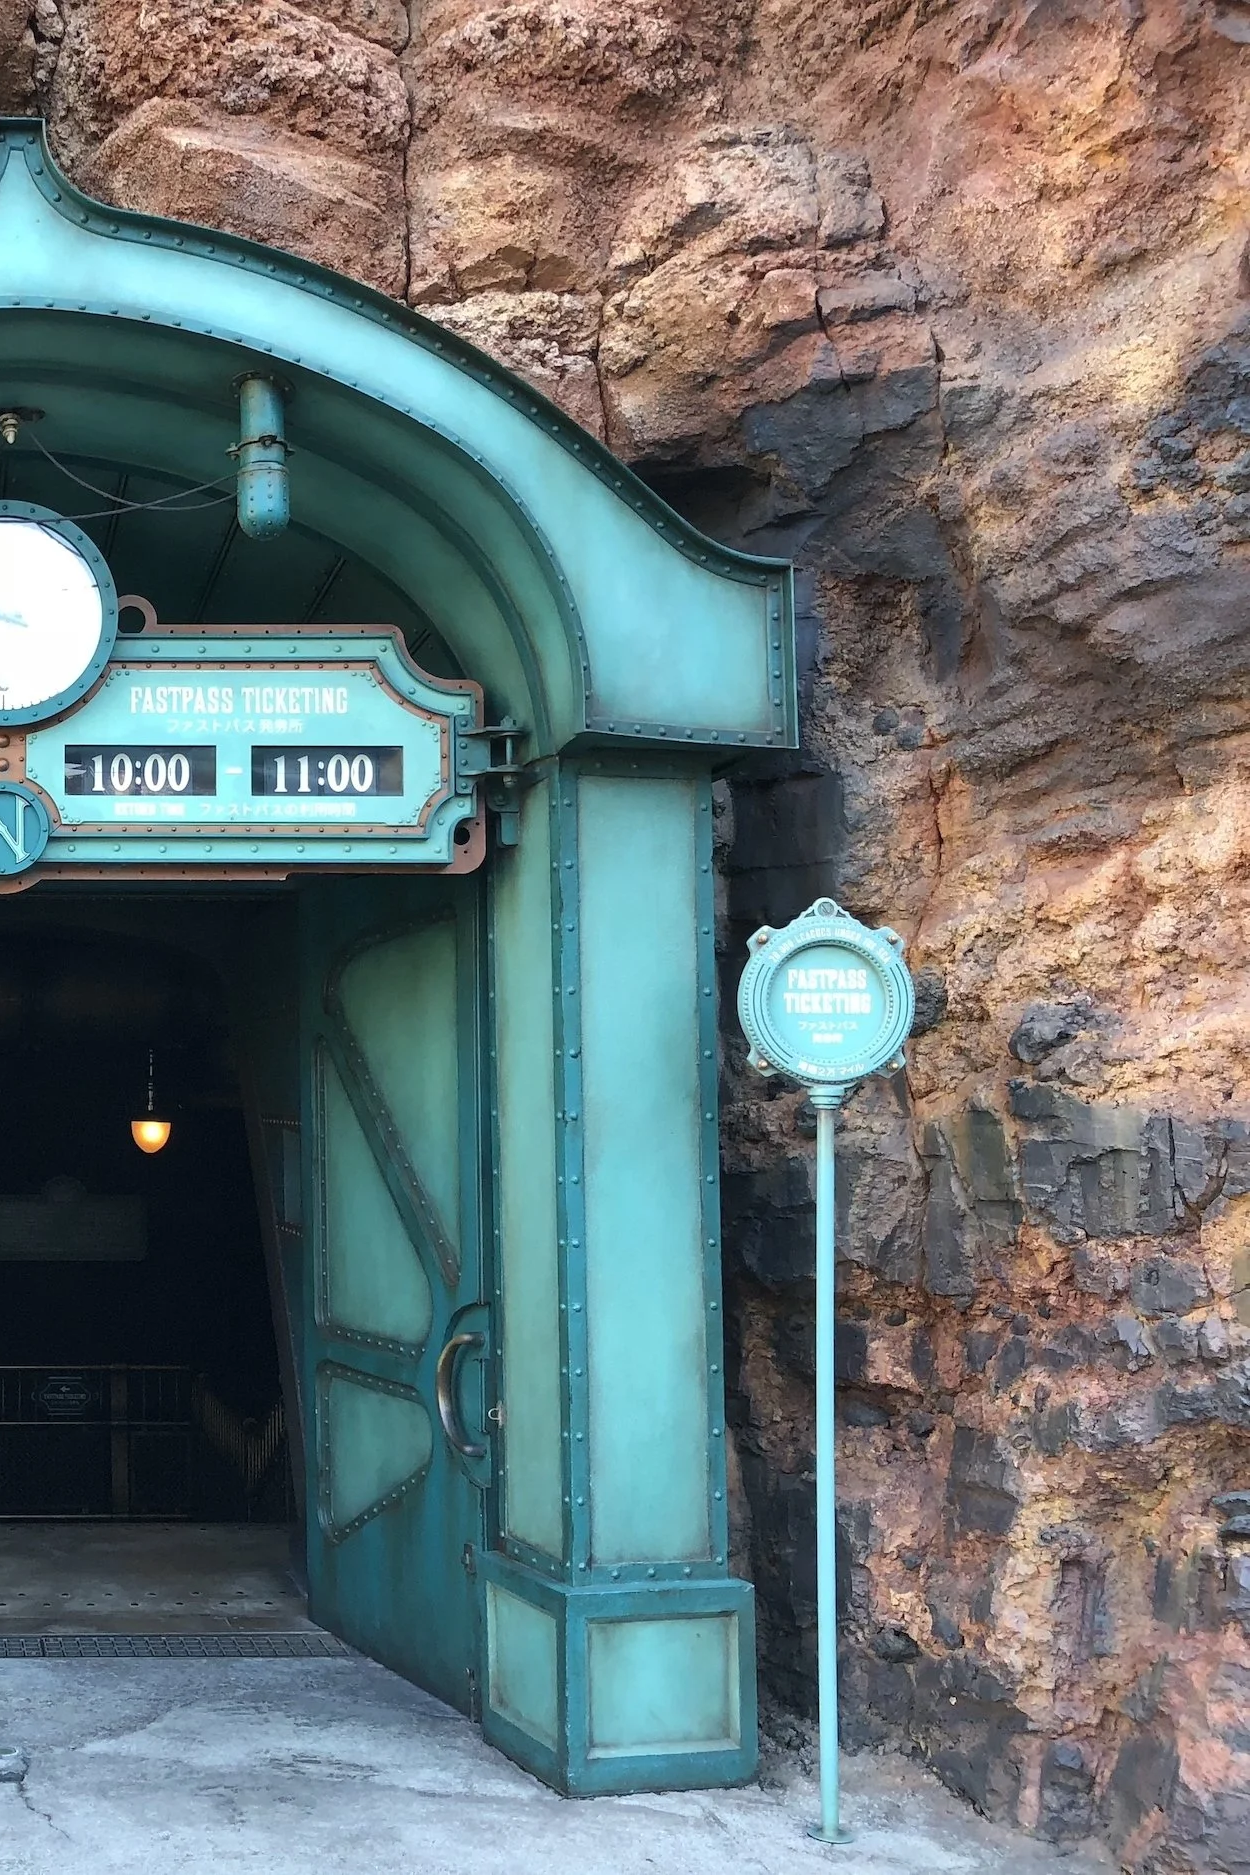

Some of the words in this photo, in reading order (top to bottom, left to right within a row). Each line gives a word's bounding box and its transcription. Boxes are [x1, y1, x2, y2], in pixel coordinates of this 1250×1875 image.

[130, 686, 234, 714] FASTPASS
[241, 686, 349, 714] TICKETING
[90, 753, 191, 793] 10:00
[273, 753, 374, 793] 11:00
[787, 968, 867, 990] FASTPASS
[783, 992, 872, 1014] TICKETING
